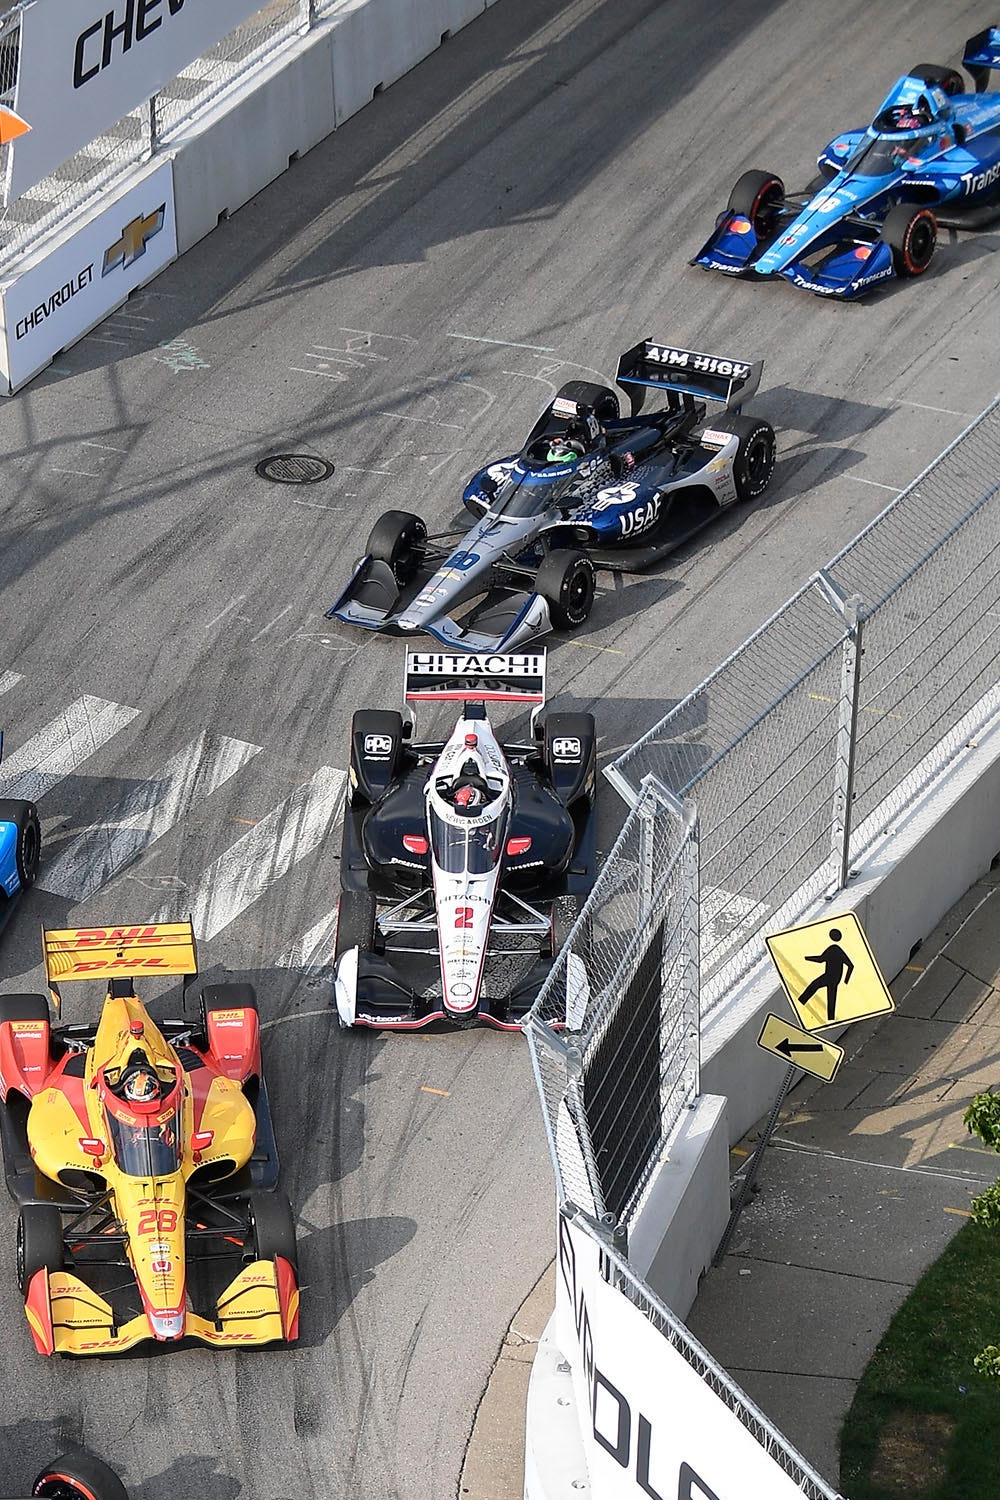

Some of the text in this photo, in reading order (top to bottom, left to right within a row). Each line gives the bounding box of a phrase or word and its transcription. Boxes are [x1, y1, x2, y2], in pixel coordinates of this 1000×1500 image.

[858, 266, 893, 286] Transcard
[15, 263, 95, 341] CHEVROLET
[645, 347, 749, 378] AIM HIGH
[619, 492, 662, 535] USAF
[411, 654, 539, 674] HITACHI
[366, 736, 391, 752] PPG
[554, 740, 580, 756] PPG
[454, 906, 474, 928] 2
[74, 927, 163, 947] DHL
[73, 958, 170, 973] DHL
[138, 1209, 178, 1236] 28
